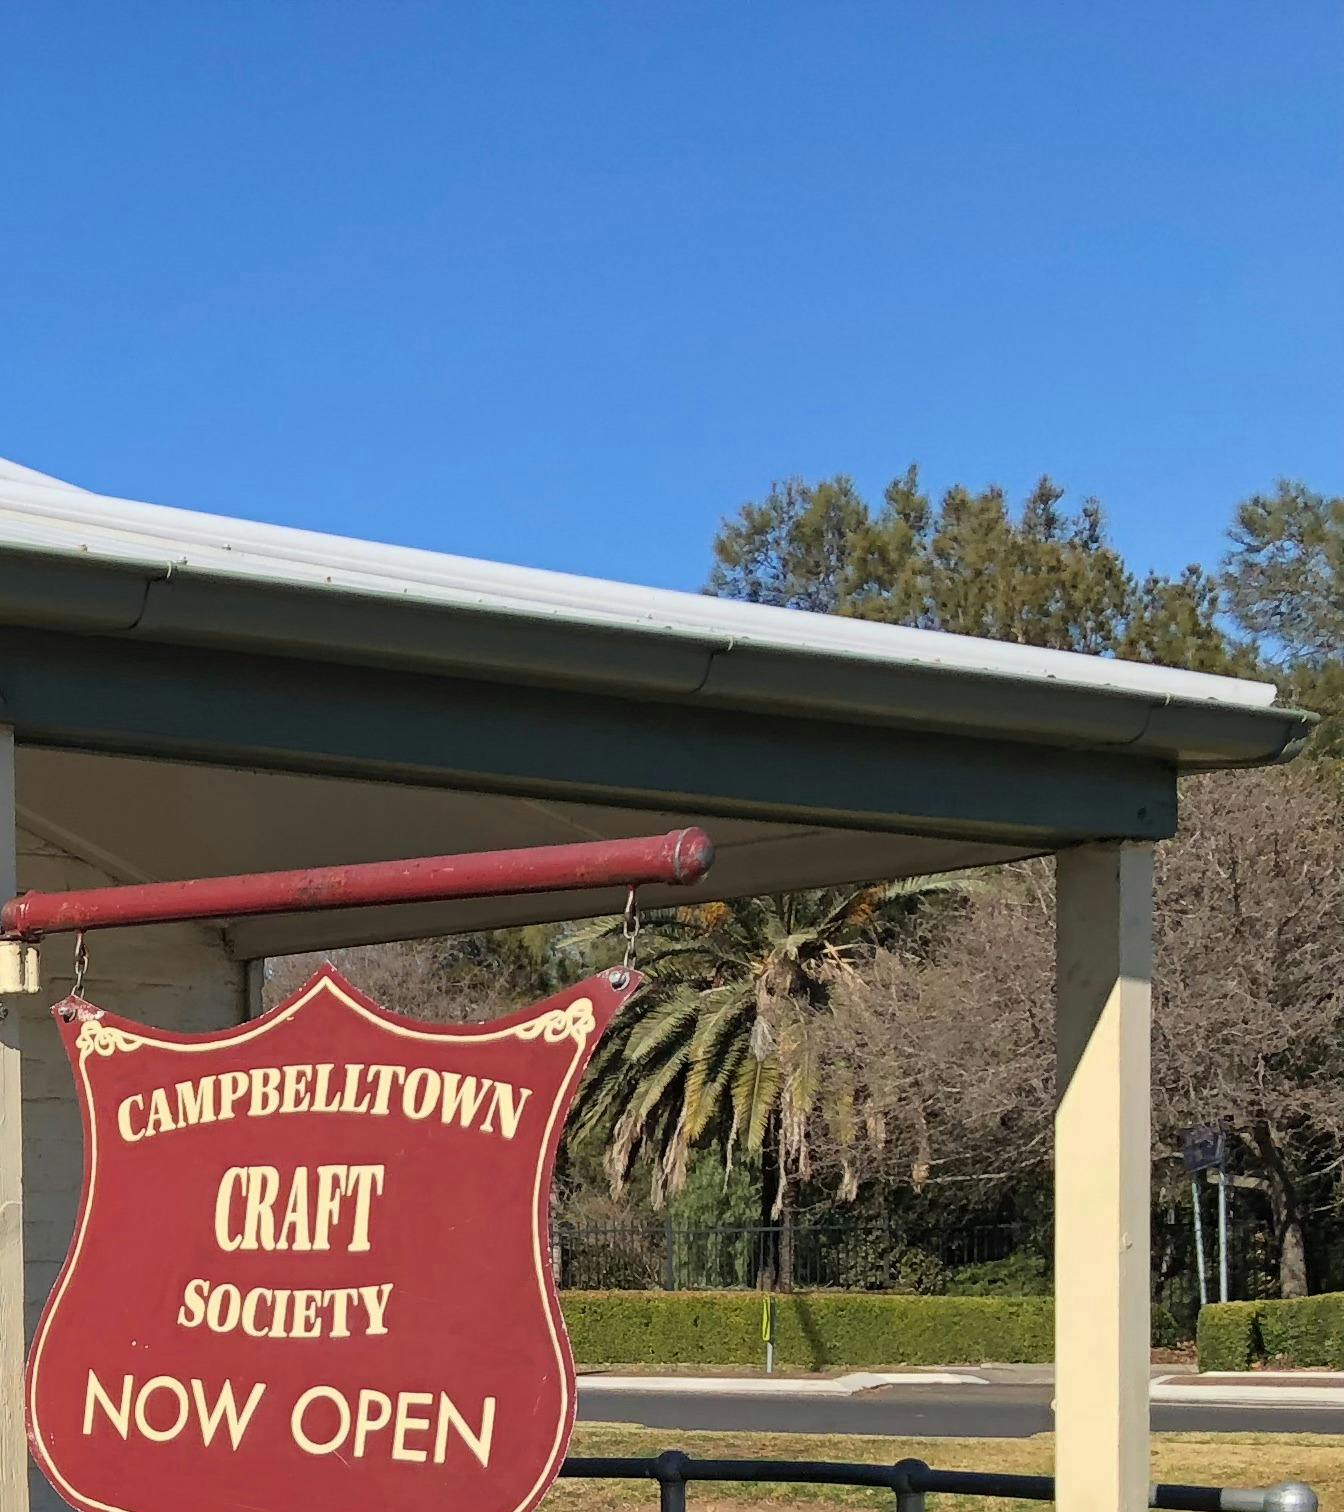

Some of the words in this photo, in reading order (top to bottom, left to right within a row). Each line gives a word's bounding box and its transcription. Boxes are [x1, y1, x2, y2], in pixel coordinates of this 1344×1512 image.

[117, 1063, 533, 1142] CAMPBELLTOWN
[214, 1164, 385, 1253] CRAFT
[176, 1278, 394, 1339] SOCIETY
[82, 1368, 267, 1452] NOW
[290, 1385, 496, 1468] OPEN
